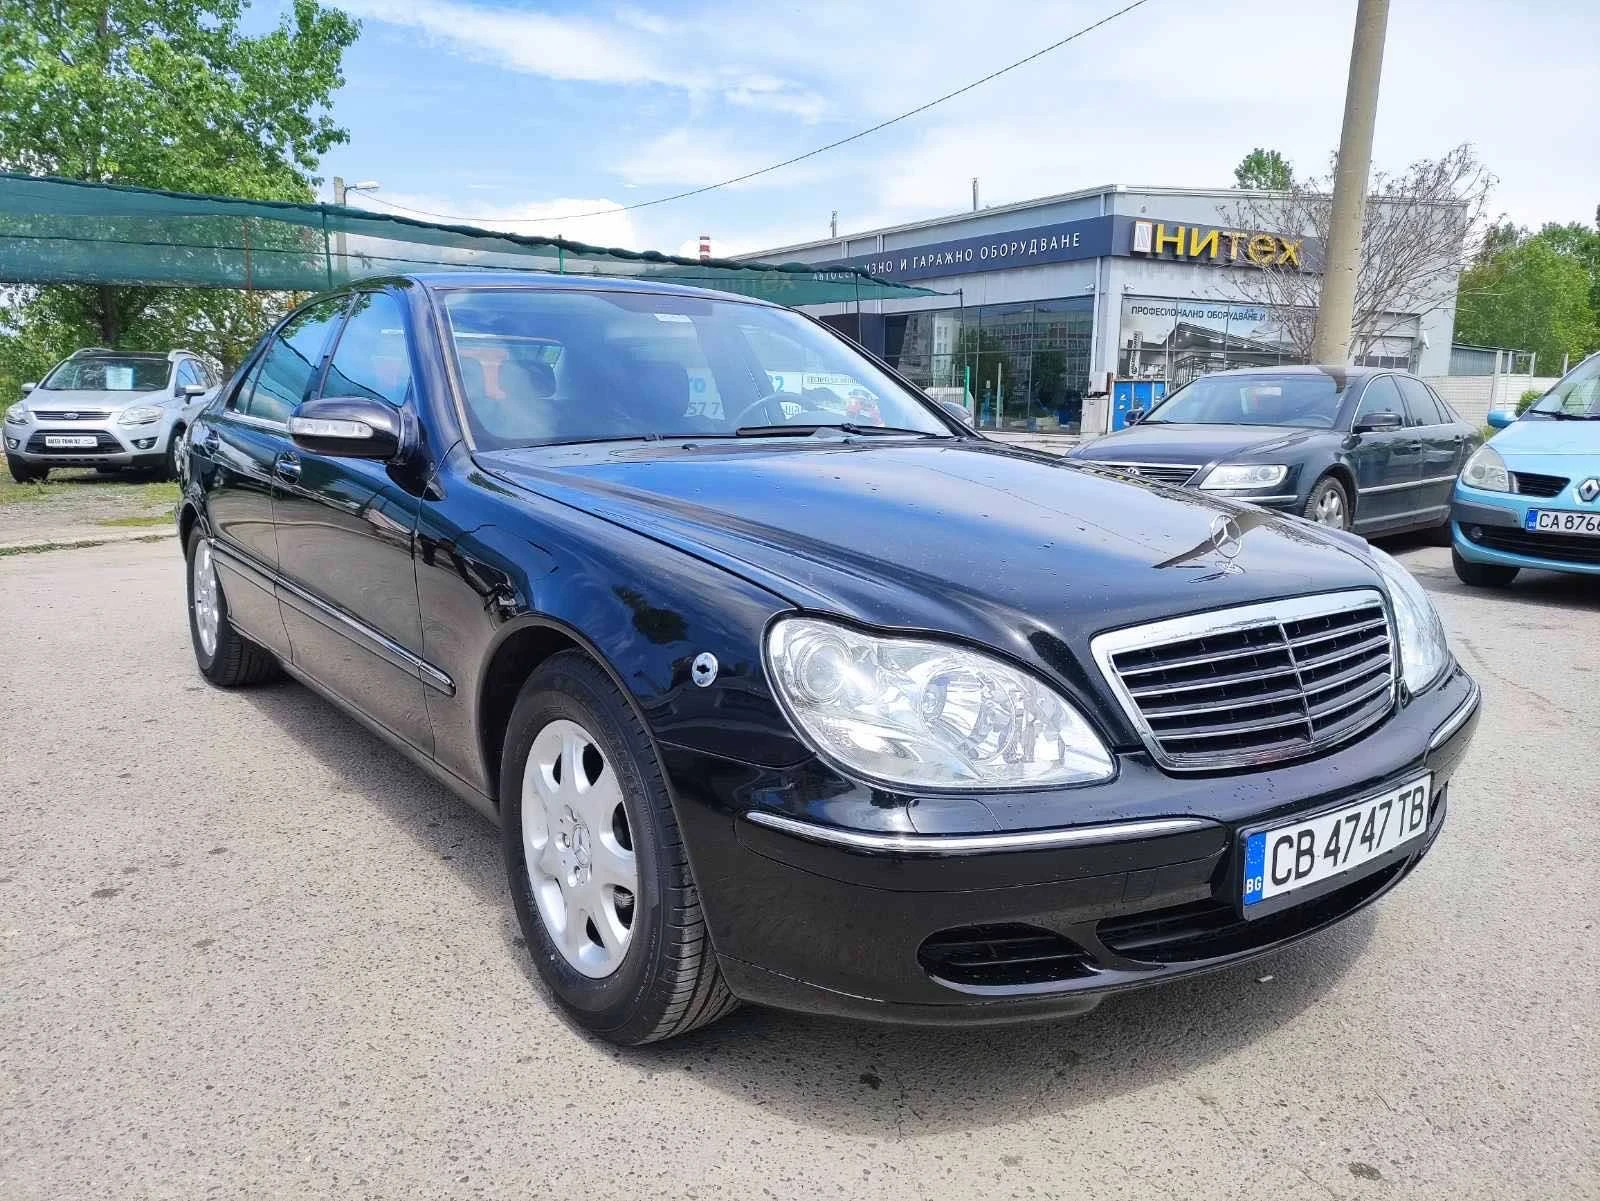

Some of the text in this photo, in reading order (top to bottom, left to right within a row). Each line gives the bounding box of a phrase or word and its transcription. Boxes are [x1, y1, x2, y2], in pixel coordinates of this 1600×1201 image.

[900, 259, 907, 271] И
[913, 248, 973, 269] ГАРАЖНО
[980, 232, 1080, 260] ОБОРУДВАНЕ
[1131, 306, 1204, 319] ПРОФЕСИОНАЛНО
[1207, 310, 1259, 322] ОБОРУДВАНЕ
[1540, 513, 1560, 529] CA
[1246, 785, 1425, 894] BG CB 4747 TB
